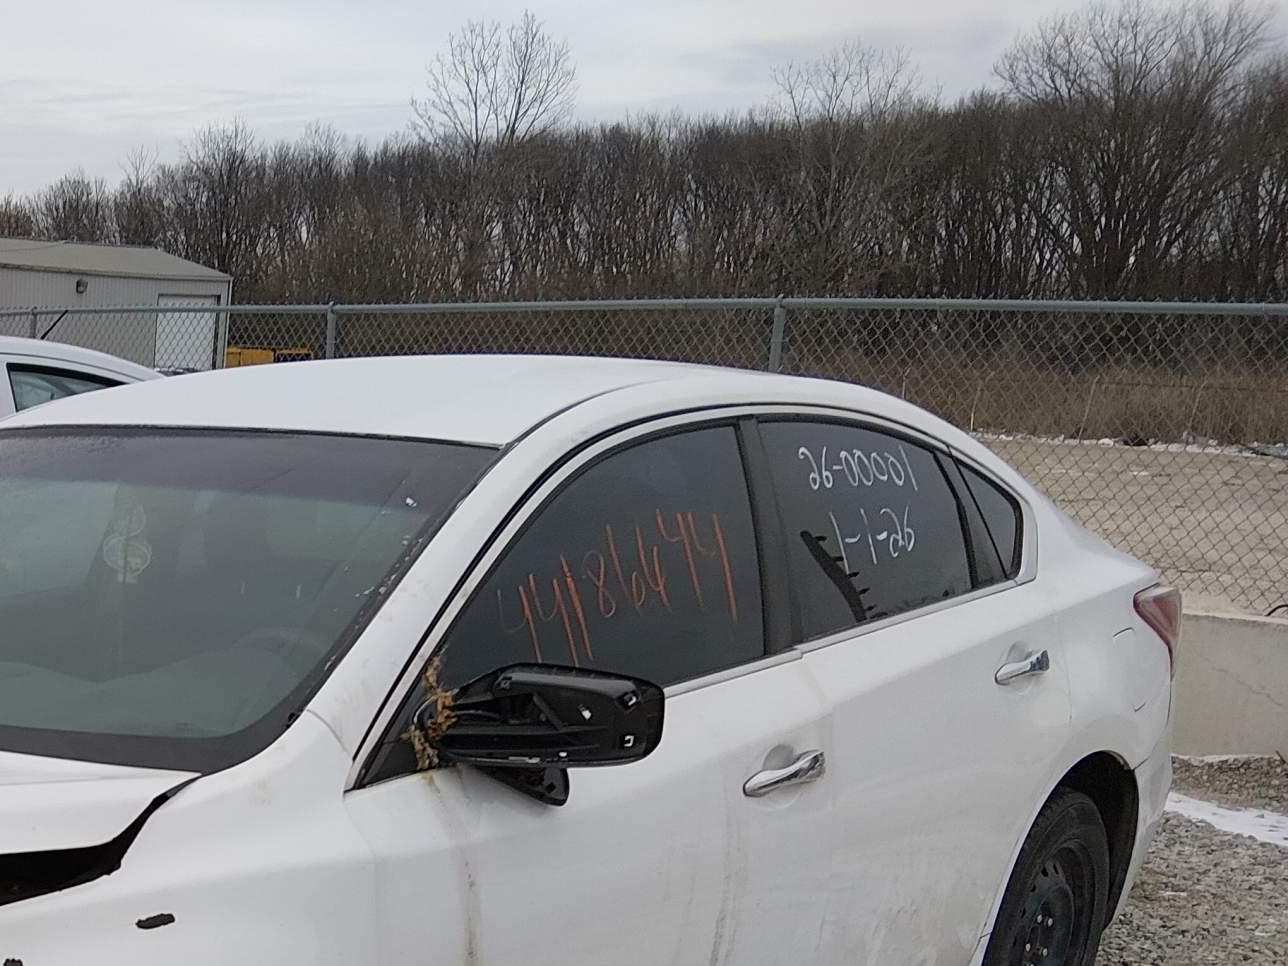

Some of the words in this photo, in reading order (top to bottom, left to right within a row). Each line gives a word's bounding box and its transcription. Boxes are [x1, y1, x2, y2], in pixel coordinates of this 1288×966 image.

[798, 446, 918, 491] 26-00001
[829, 504, 916, 575] 1-1-26
[496, 508, 739, 667] 44186644
